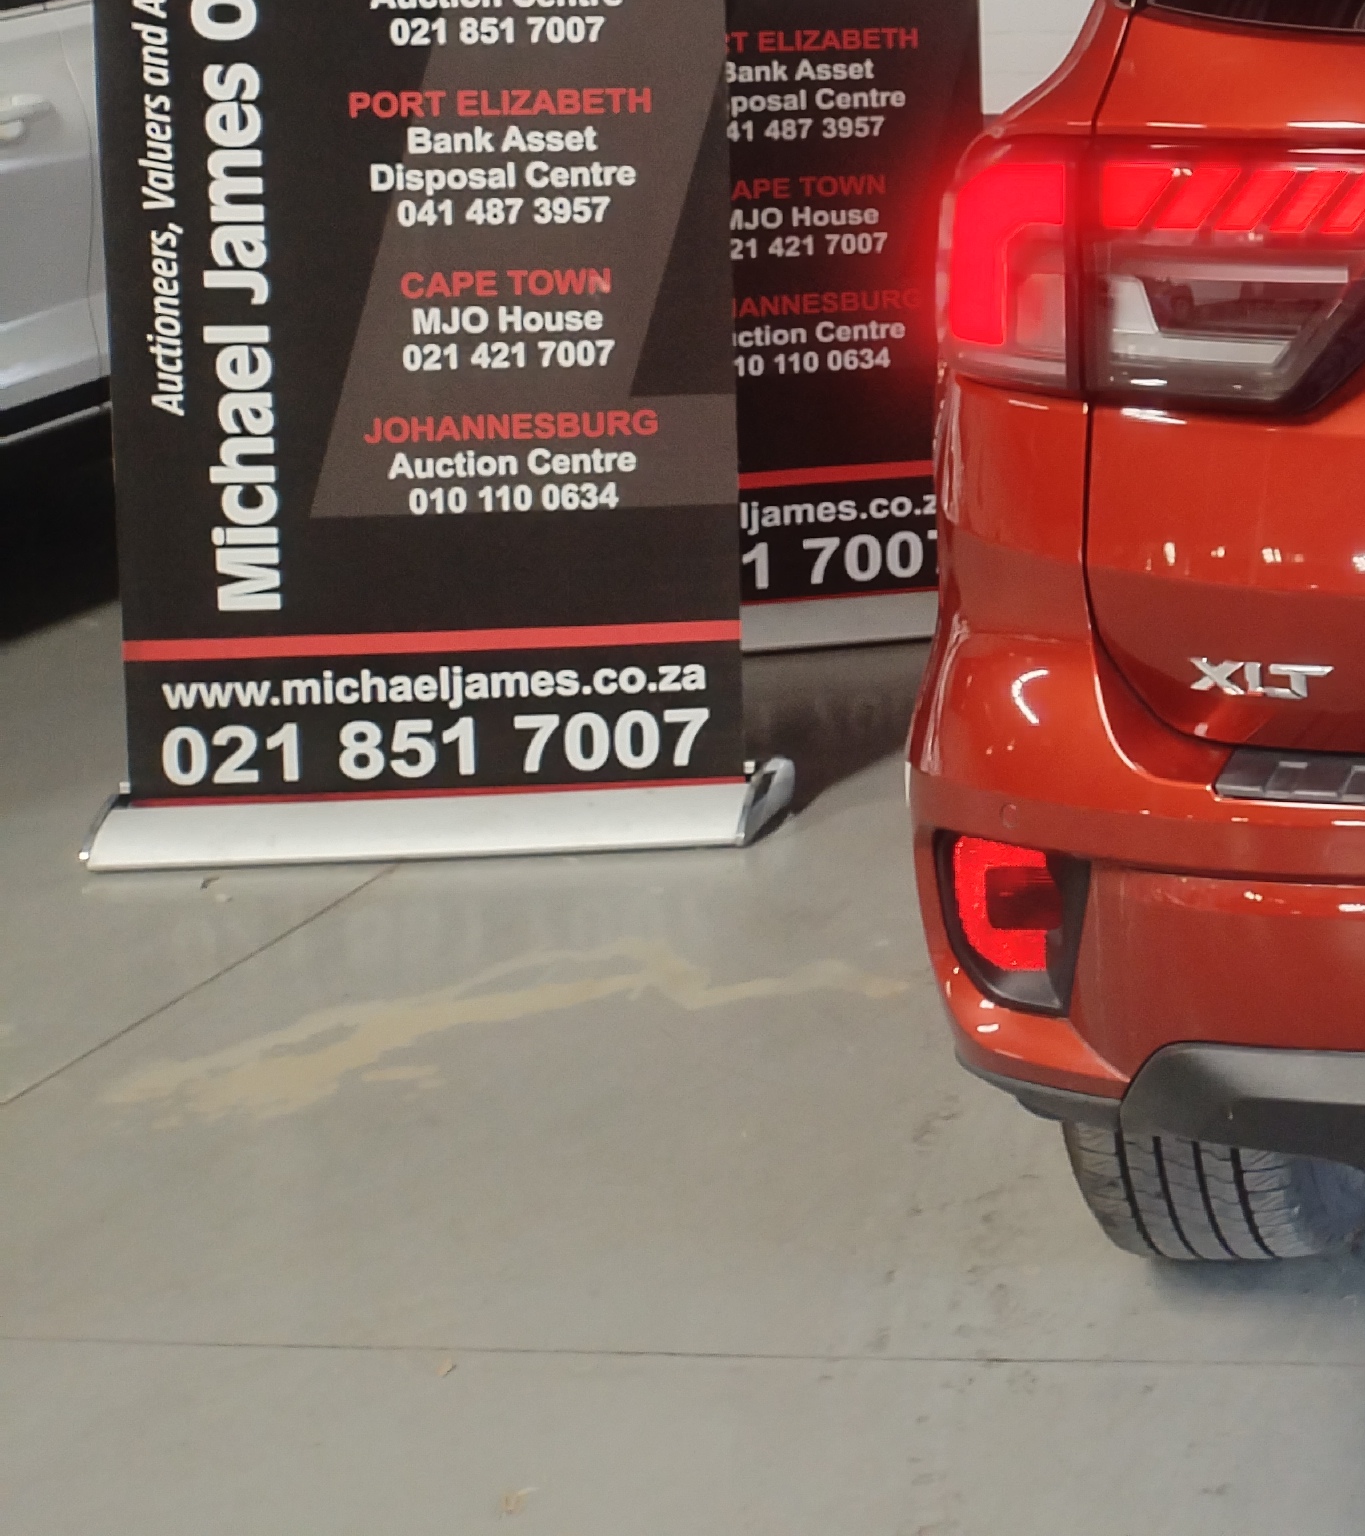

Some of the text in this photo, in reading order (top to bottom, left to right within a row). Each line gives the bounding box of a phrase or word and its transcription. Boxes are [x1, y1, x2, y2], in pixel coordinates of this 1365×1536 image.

[389, 15, 605, 46] 021 851 7007
[758, 27, 919, 52] ELIZABETH
[131, 21, 170, 87] and
[794, 58, 875, 81] Asset
[349, 87, 652, 119] PORT ELIZABETH
[730, 87, 906, 117] posal Centre
[407, 125, 598, 153] Bank Asset
[764, 115, 885, 141] 487 3957
[137, 93, 176, 210] Valuers
[202, 62, 270, 305] James
[370, 160, 637, 197] Disposal Centre
[731, 174, 886, 201] APE TOWN
[397, 195, 611, 228] 041 487 3957
[791, 205, 880, 227] House
[768, 231, 889, 257] 421 7007
[400, 267, 611, 299] CAPE TOWN
[146, 222, 185, 417] Auctioneers,
[412, 305, 604, 334] MJO House
[732, 290, 921, 318] ANNESBURG
[732, 320, 906, 347] ction Centre
[402, 339, 616, 372] 021 421 7007
[774, 346, 892, 375] 110 0634
[363, 409, 659, 444] JOHANNESBURG
[202, 325, 282, 611] Michael
[387, 447, 637, 480] Auction Centre
[408, 481, 620, 515] 010 110 0634
[161, 663, 706, 710] www.michaeljames.co.za
[1189, 658, 1334, 700] XLT
[161, 707, 710, 786] 021 851 7007
